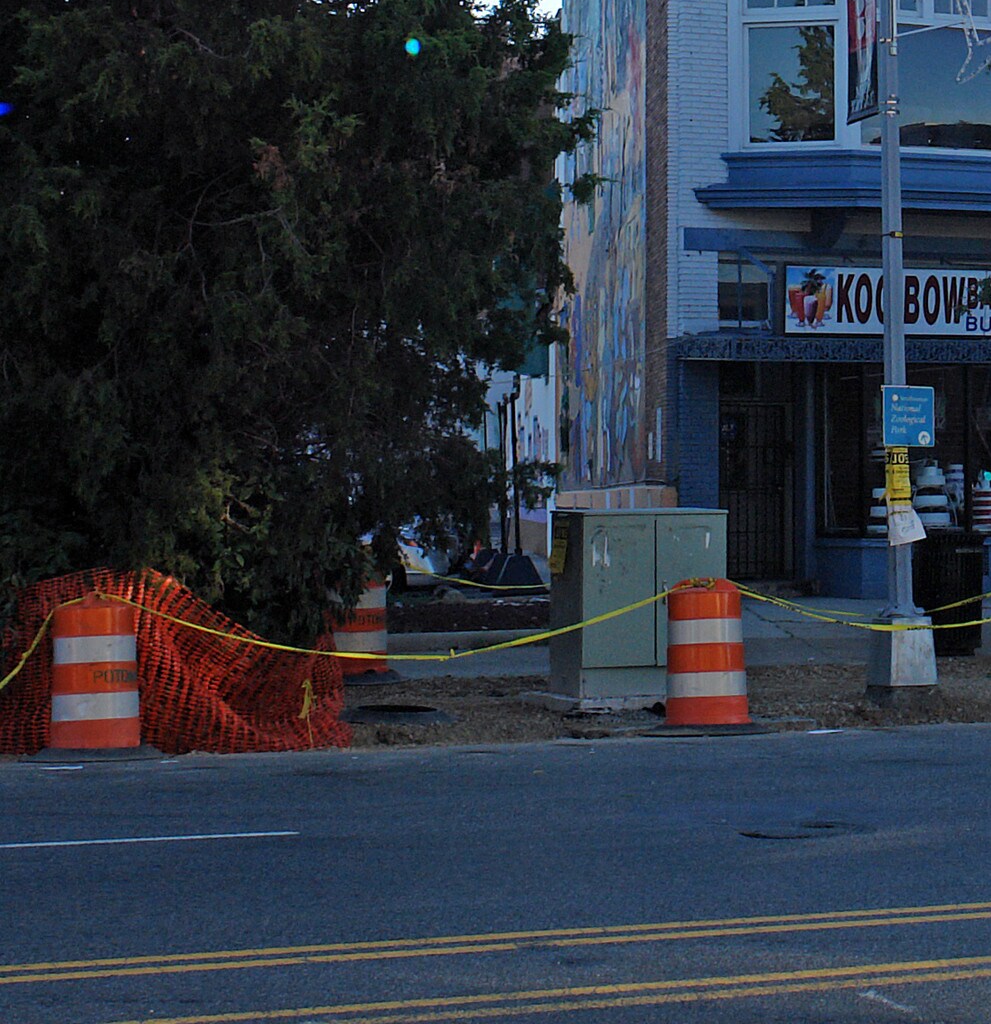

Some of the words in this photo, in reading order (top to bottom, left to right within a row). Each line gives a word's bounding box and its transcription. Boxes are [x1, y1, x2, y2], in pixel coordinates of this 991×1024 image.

[836, 273, 967, 325] KOBOW
[891, 403, 922, 413] National
[891, 414, 926, 425] Zoological
[891, 425, 908, 434] Park
